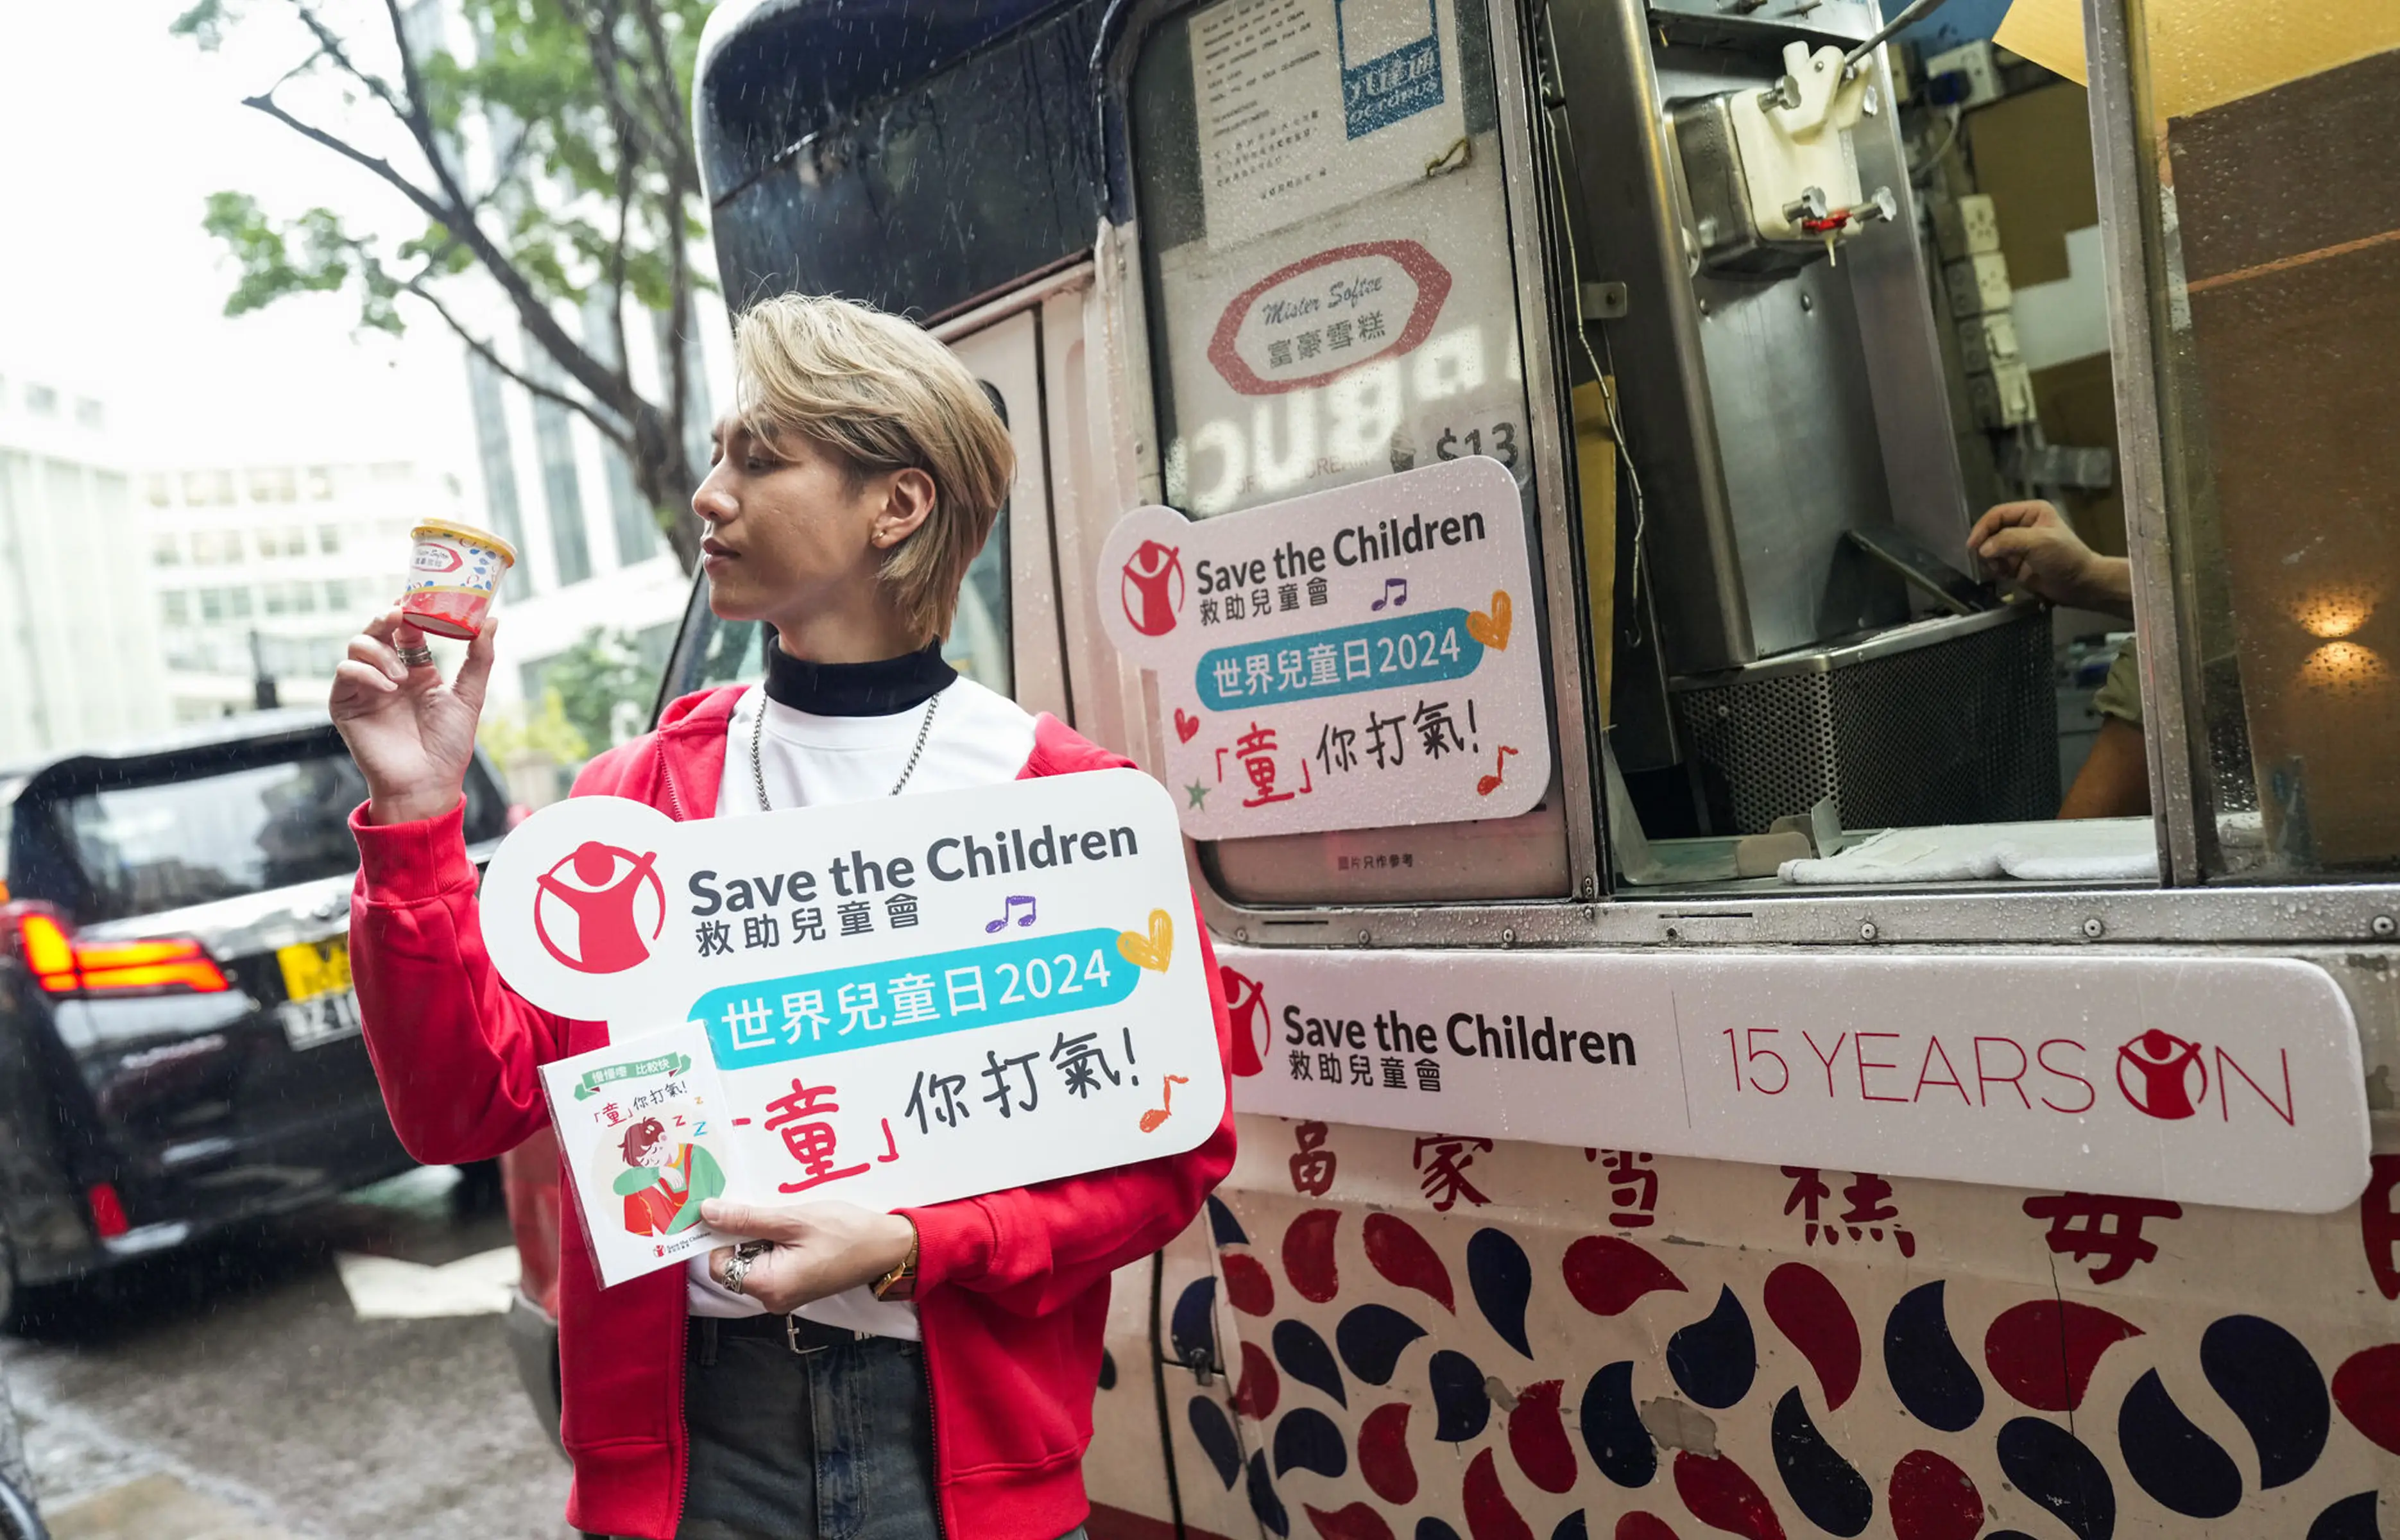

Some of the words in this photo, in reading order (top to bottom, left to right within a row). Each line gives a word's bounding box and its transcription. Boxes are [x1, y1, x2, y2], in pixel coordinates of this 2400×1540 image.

[1262, 298, 1321, 326] Mister
[1267, 310, 1385, 369] 富豪雪糕
[1196, 558, 1265, 595] Save
[1273, 542, 1326, 579] the
[1333, 511, 1486, 567] Children
[1200, 577, 1328, 626] 救助兒童會
[1213, 626, 1461, 698] 世界兒童日2024
[689, 869, 818, 917] Save
[828, 850, 915, 896] the
[927, 825, 1138, 882] Children
[696, 893, 919, 957] 救助兒童會
[721, 949, 1111, 1052] 世界兒童日2024
[1283, 1005, 1366, 1049] Save
[1374, 1010, 1437, 1054] the
[1446, 1012, 1636, 1066] Children
[1289, 1050, 1441, 1092] 救助兒童會
[1723, 1027, 1790, 1095] 15
[1802, 1031, 2095, 1113] YEARS
